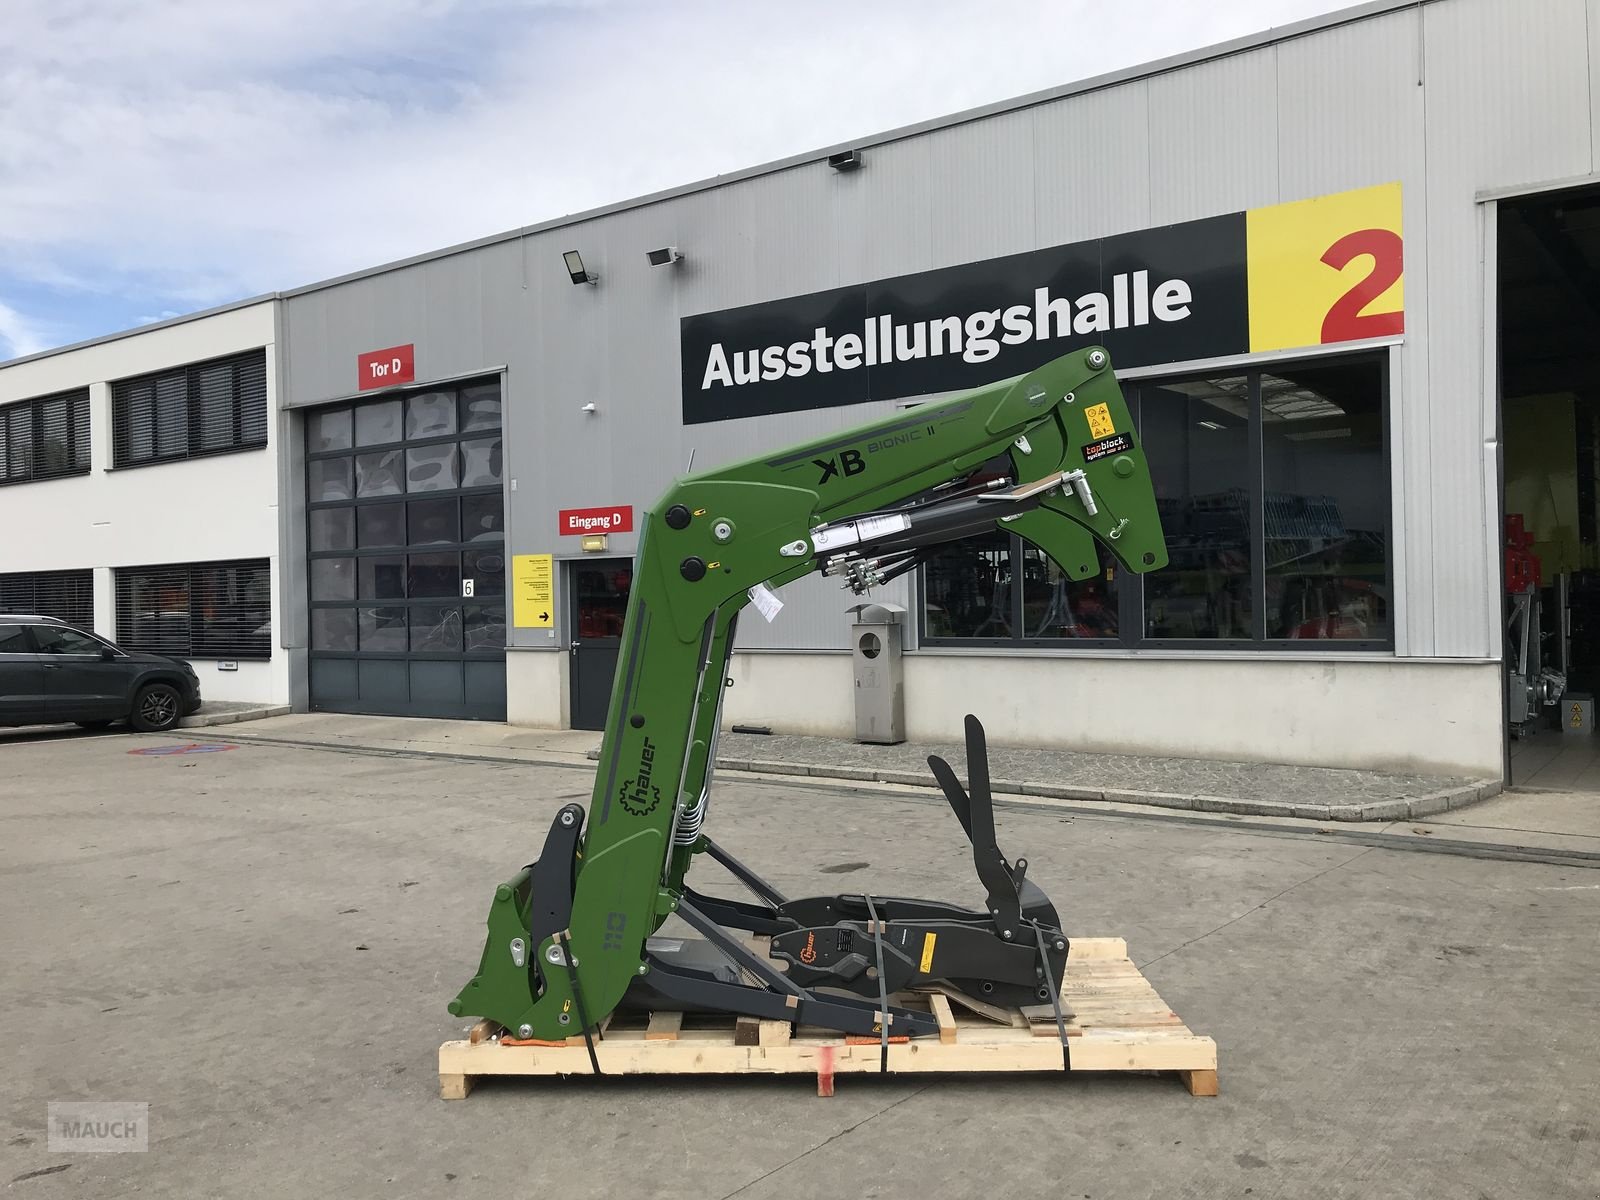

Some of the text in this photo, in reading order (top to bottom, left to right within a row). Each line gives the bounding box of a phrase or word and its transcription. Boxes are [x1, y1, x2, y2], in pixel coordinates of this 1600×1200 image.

[701, 228, 1405, 390] Ausstellungshalle 2
[370, 358, 402, 378] Tor D
[867, 430, 922, 453] BIONIC
[1086, 436, 1125, 455] topblock
[569, 513, 622, 530] Eingang D
[465, 581, 472, 595] 6
[628, 736, 656, 804] hauer
[803, 930, 815, 959] hauer
